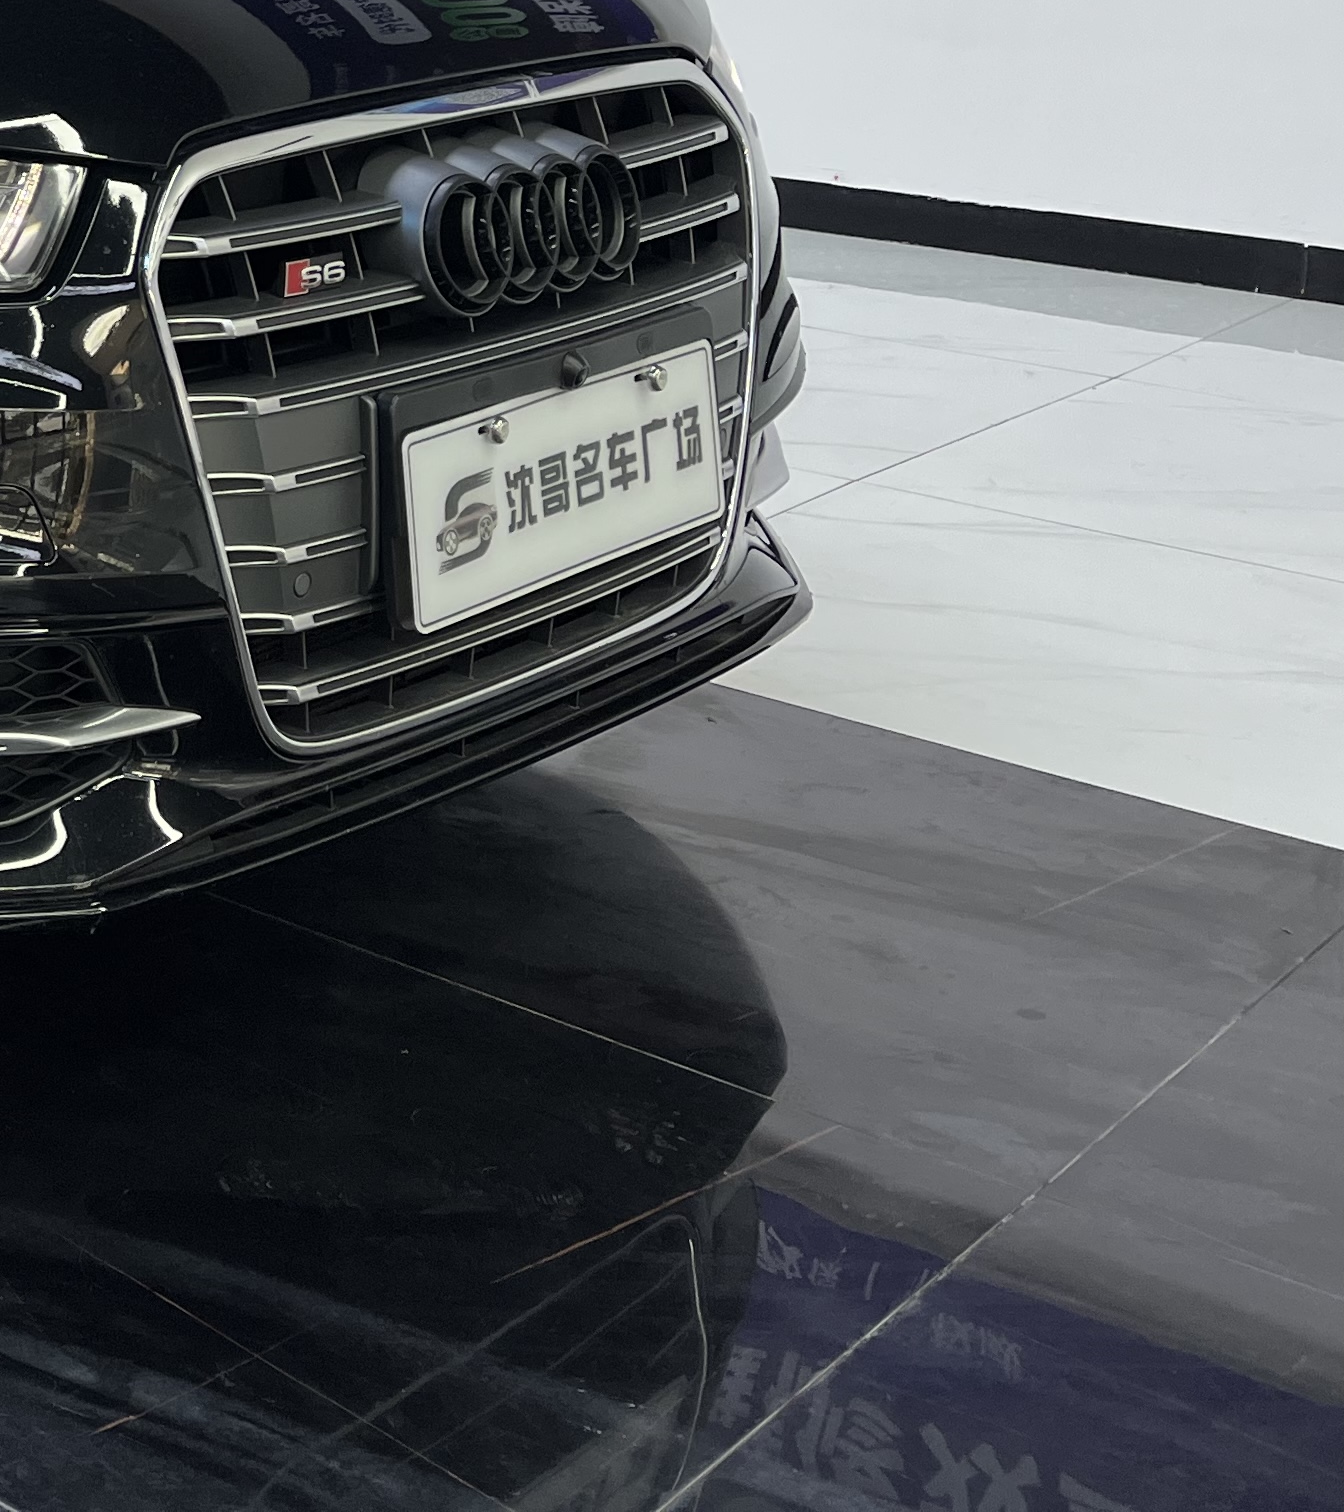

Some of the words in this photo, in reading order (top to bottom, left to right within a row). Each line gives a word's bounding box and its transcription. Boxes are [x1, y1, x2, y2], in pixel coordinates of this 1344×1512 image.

[299, 259, 347, 288] S6
[504, 405, 703, 534] 沈哥名车广场
